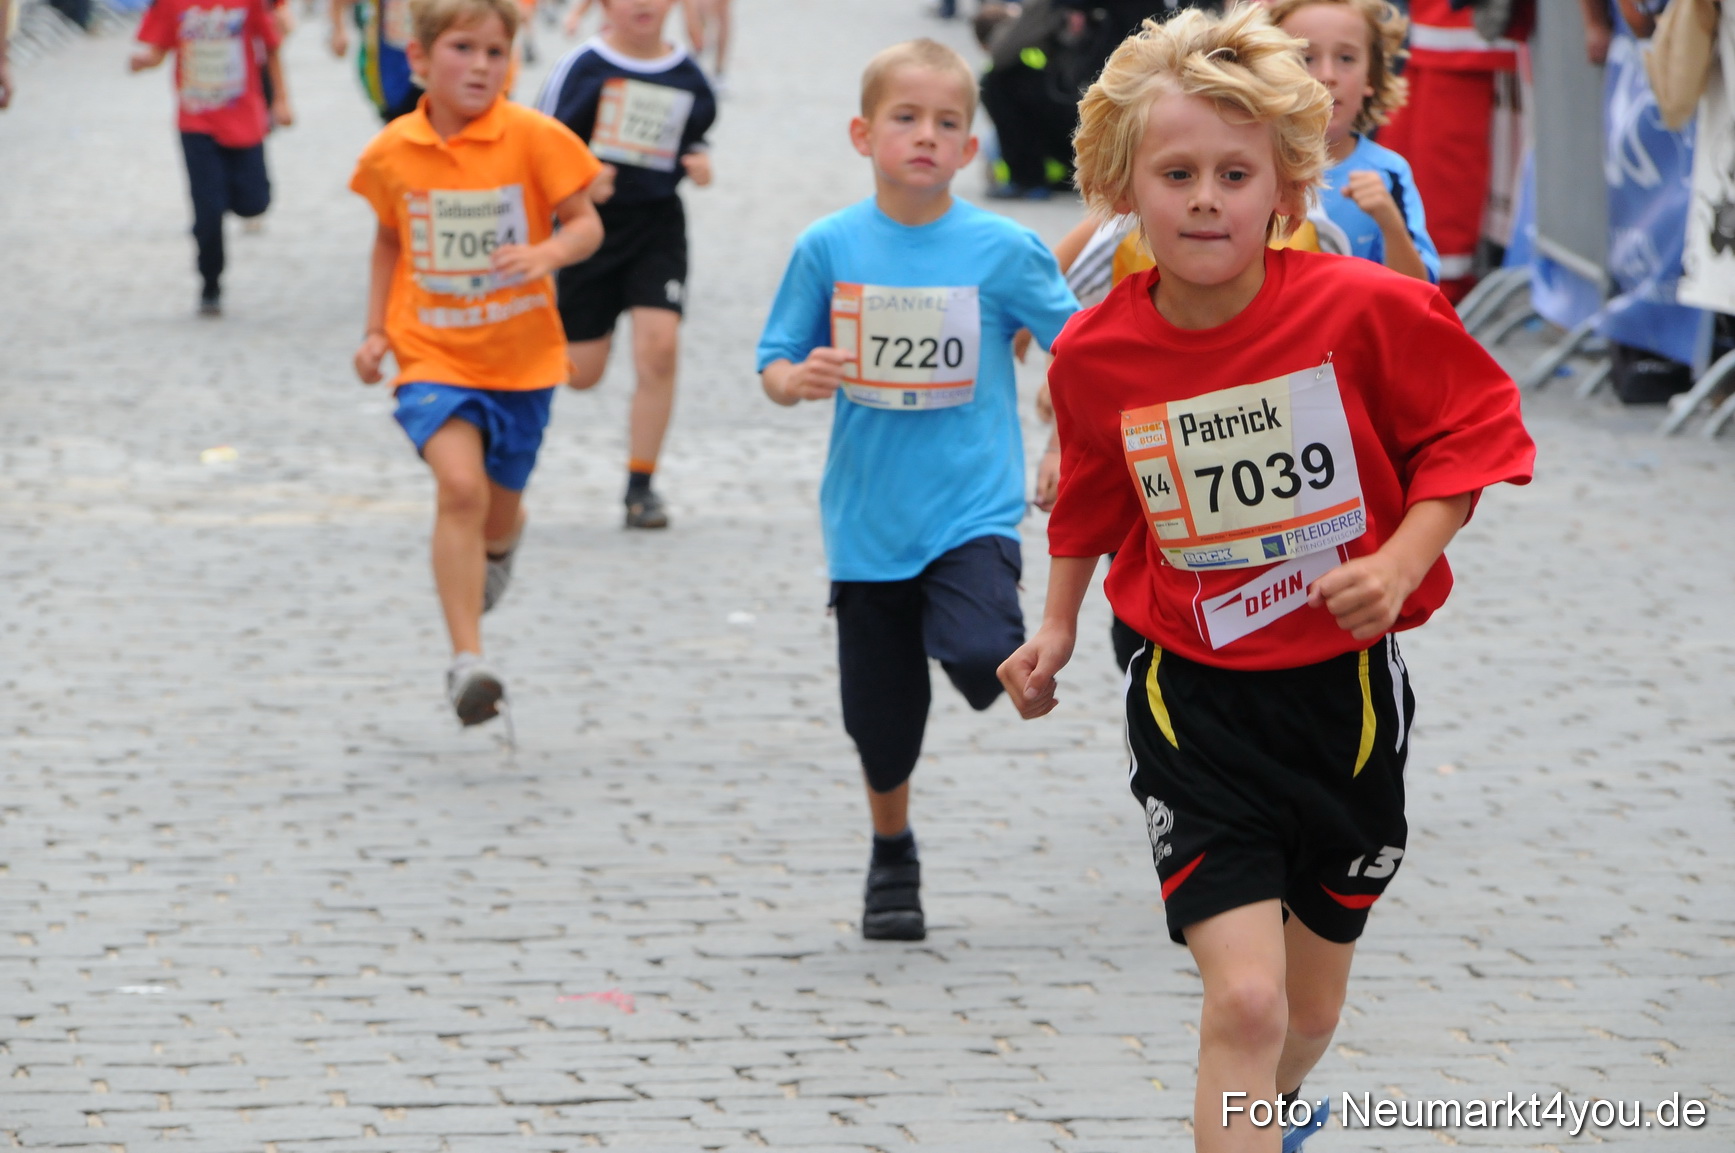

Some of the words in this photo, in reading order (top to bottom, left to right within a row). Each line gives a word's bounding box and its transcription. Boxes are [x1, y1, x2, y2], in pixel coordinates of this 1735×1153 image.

[871, 336, 963, 369] 7220
[1179, 398, 1282, 446] Patrick
[1141, 474, 1171, 498] K4
[1194, 442, 1336, 513] 7039
[1285, 509, 1364, 546] PFLEIDERER
[1245, 570, 1303, 618] DEHN
[1347, 845, 1404, 879] 13
